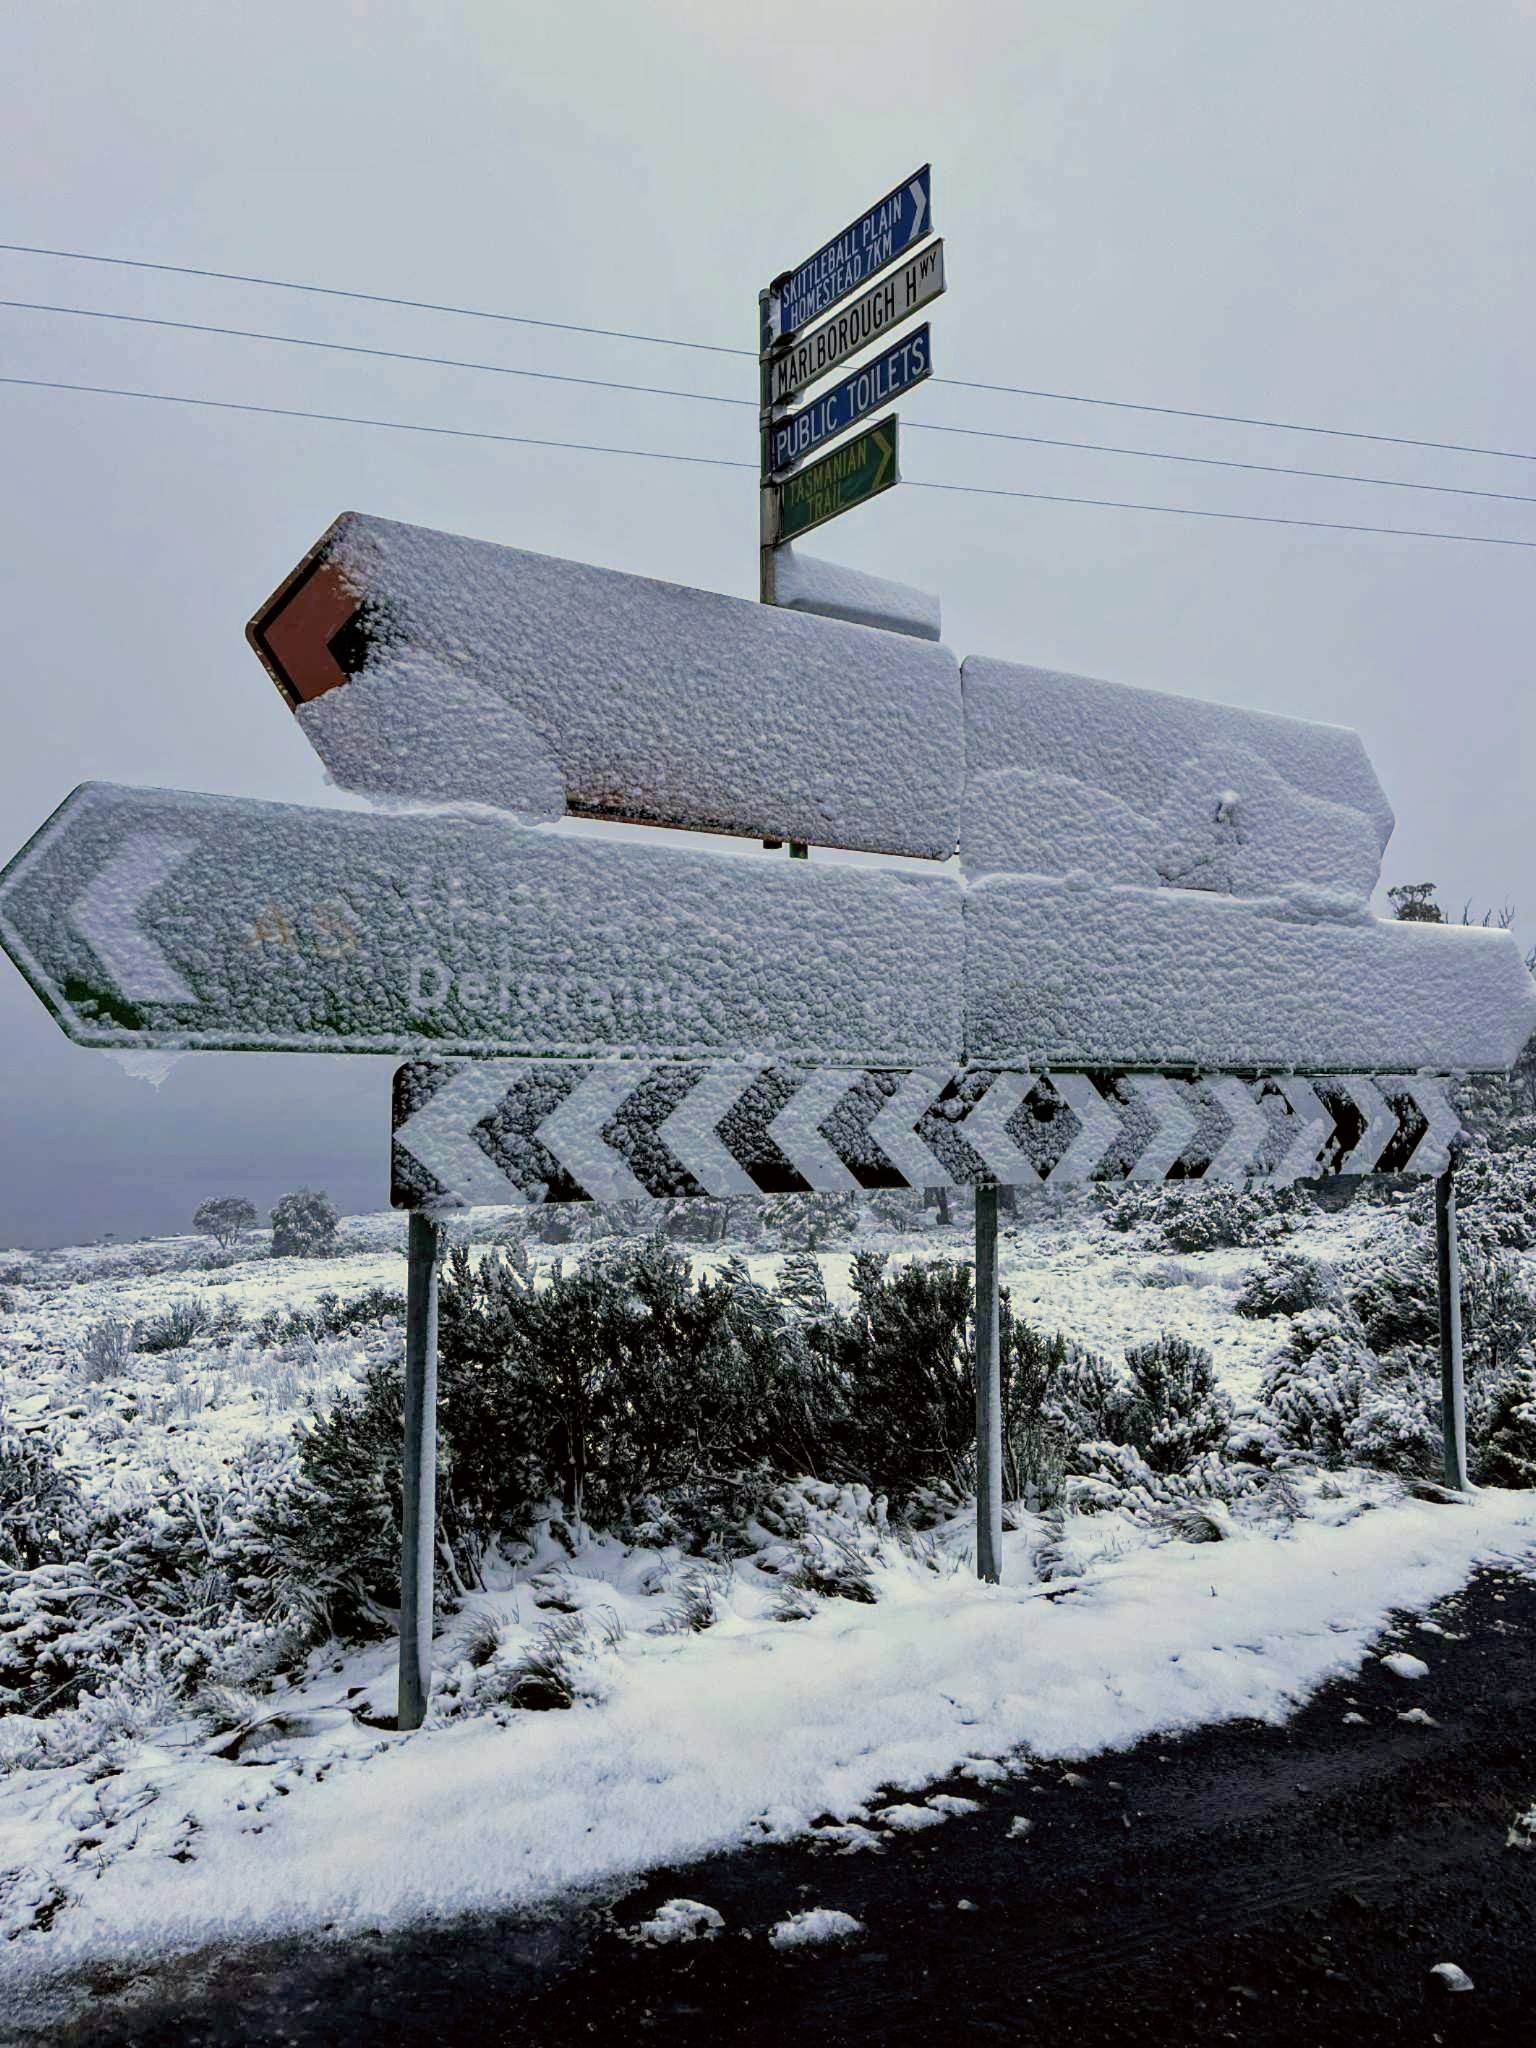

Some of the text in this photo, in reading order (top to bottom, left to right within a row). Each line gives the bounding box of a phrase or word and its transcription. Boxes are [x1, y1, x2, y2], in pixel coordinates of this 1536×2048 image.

[783, 192, 902, 308] SKITTLEBALL PLAIN
[791, 229, 892, 329] HOMESTEAD 7KM
[778, 282, 895, 394] MARLBOROUGH
[776, 336, 924, 465] PUBLIC TOILETS
[789, 438, 866, 506] TASMANIAN
[807, 484, 844, 521] TRAIL
